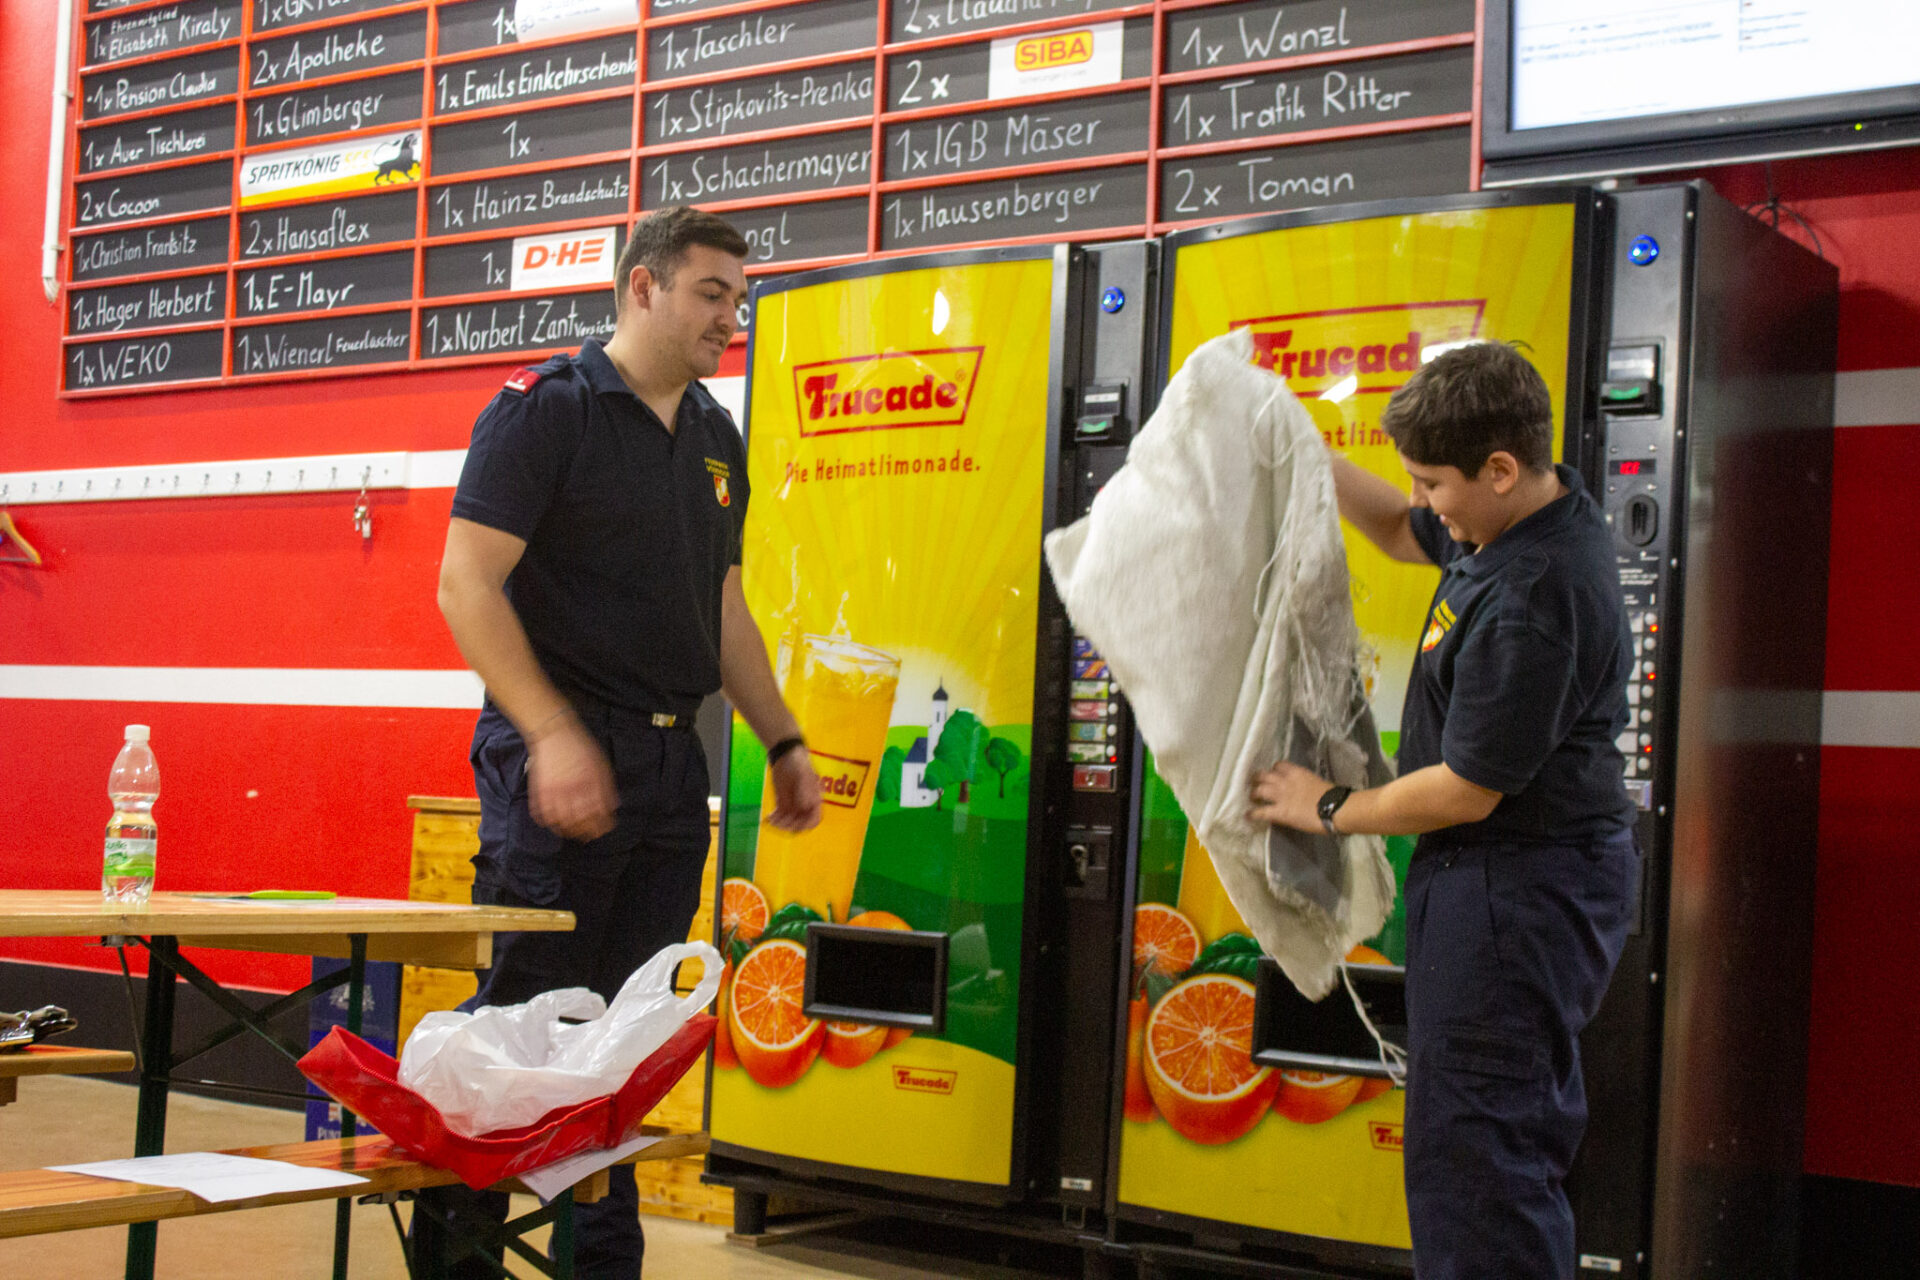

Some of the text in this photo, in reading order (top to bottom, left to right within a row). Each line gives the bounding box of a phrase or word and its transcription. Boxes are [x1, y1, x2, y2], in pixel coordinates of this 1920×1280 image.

[108, 26, 168, 61] Elisabeth
[178, 7, 231, 42] Kiraly
[492, 7, 516, 45] 1x
[659, 16, 796, 71] 1x Taschler
[1182, 8, 1350, 65] 1x Wanzl
[253, 29, 387, 86] 2x Apotheke
[1020, 37, 1088, 66] SIBA
[116, 78, 166, 108] Pension
[169, 72, 217, 98] Claudia
[438, 73, 459, 110] 1x
[463, 68, 515, 107] Emils
[654, 71, 873, 138] 1x Stipkovits-Prenka
[1173, 71, 1412, 141] 1x Trafik Ritter
[253, 92, 384, 138] 1x Glimberger
[502, 120, 531, 159] 1x
[84, 127, 206, 171] 1x Auer Tischlerei
[895, 128, 928, 173] 1x
[934, 120, 989, 168] IGB
[651, 149, 873, 202] 1x Schachermayer
[1174, 157, 1355, 213] 2x Toman
[80, 188, 160, 222] 2x Cocoon
[437, 175, 630, 229] 1x Hainz Brandschutz
[885, 183, 1103, 239] 1x Hausenberger
[91, 237, 142, 269] Christian
[245, 206, 370, 256] 2x Hansaflex
[481, 252, 506, 286] 1x
[74, 280, 216, 332] 1x Hager Herbert
[427, 314, 454, 353] 1x
[455, 303, 525, 352] Norbert
[530, 300, 578, 343] Zant
[100, 341, 171, 382] WEKO
[238, 334, 264, 371] 1x
[1250, 329, 1424, 379] Frucad
[803, 373, 959, 421] Frucade
[815, 448, 981, 482] Heimatlimonade.
